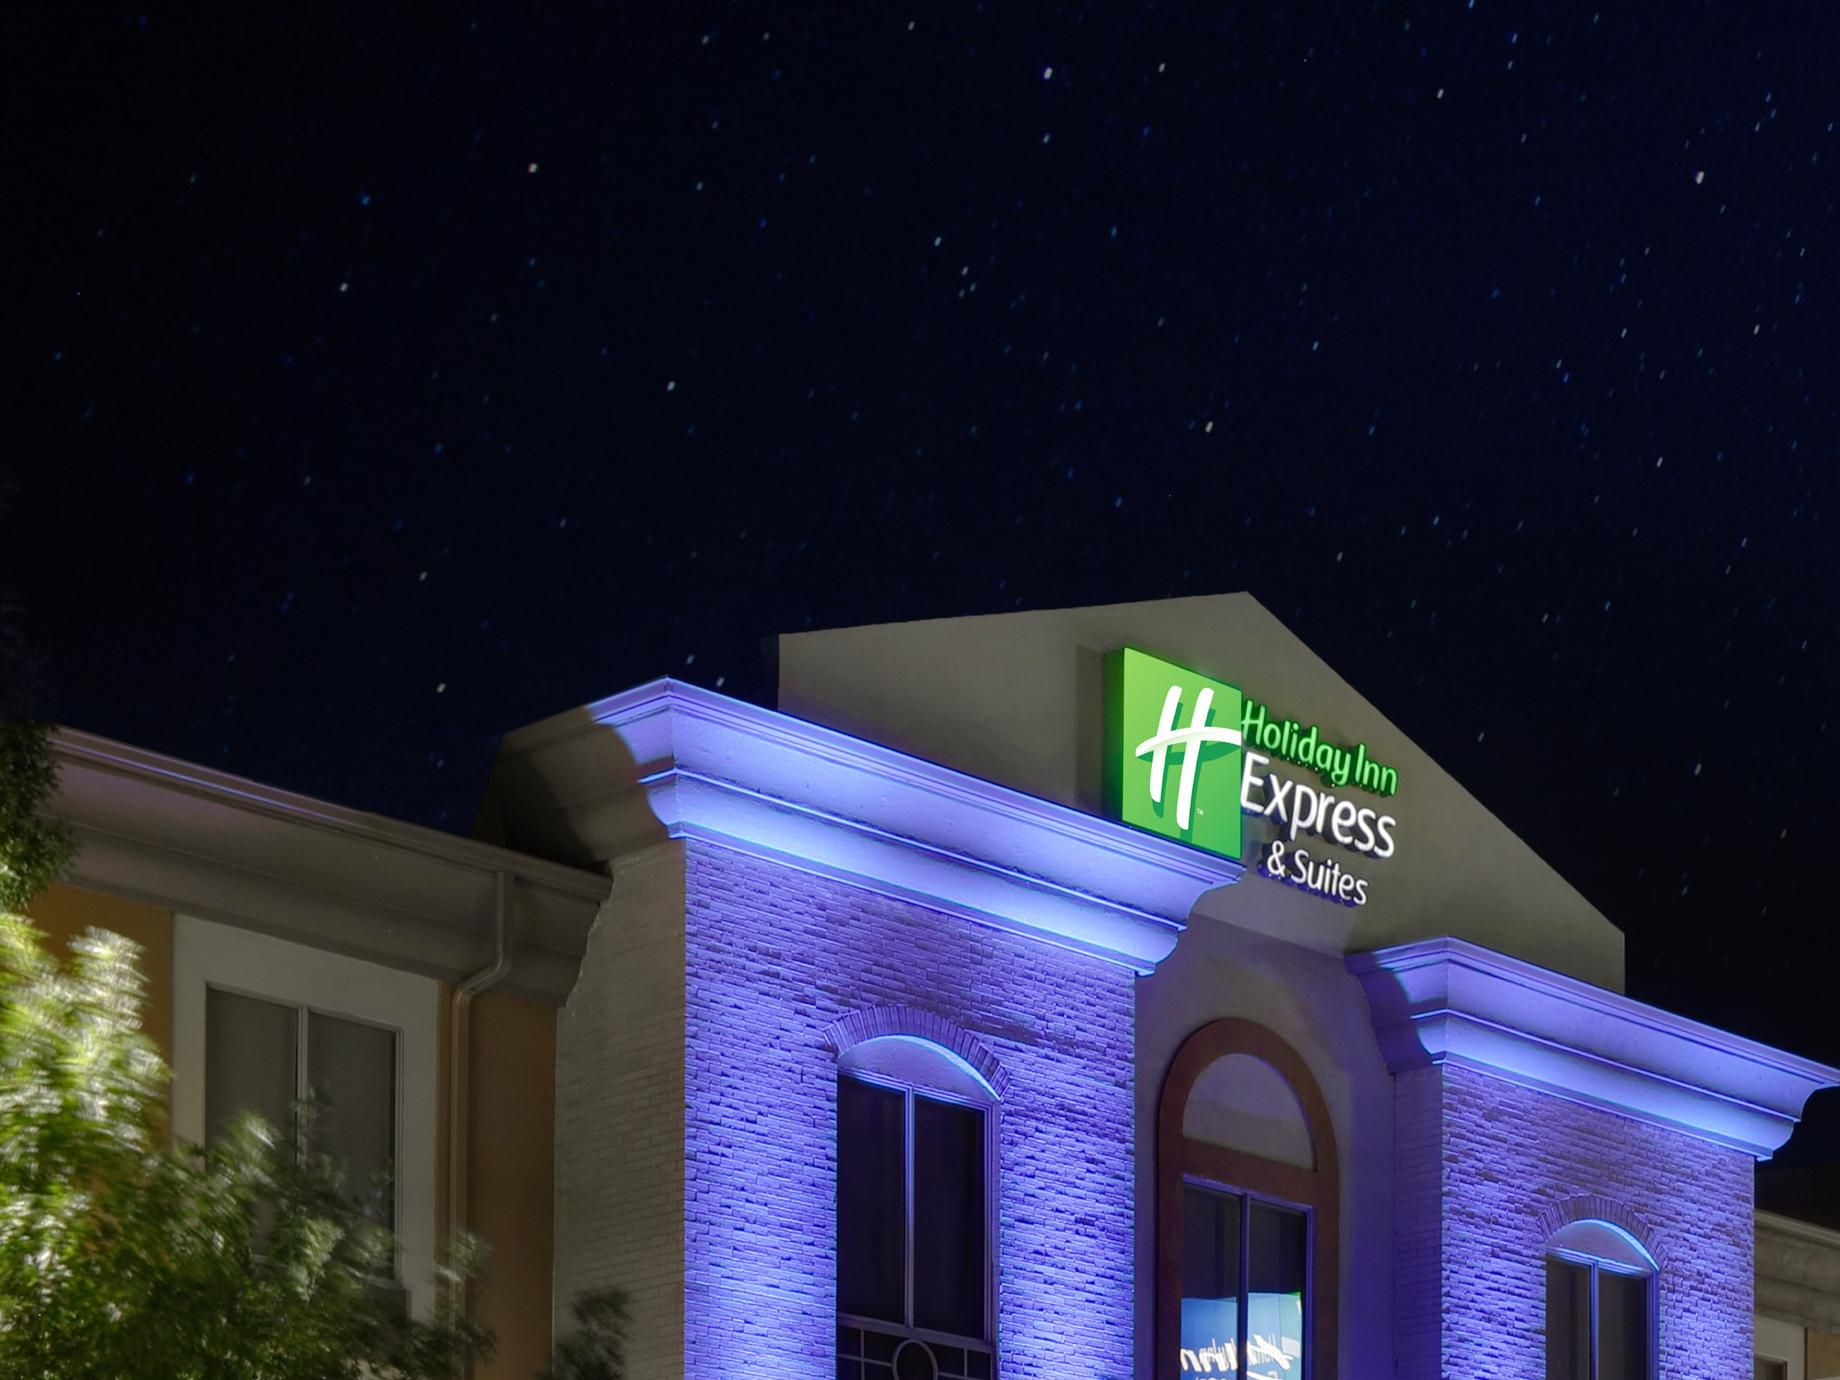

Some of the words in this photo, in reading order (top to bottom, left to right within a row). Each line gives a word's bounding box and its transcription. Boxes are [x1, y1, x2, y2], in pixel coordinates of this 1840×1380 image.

[1241, 700, 1351, 786] Holiday
[1355, 743, 1397, 796] Inn
[1240, 751, 1397, 858] Express
[1267, 840, 1286, 878] &
[1290, 849, 1369, 905] Suites
